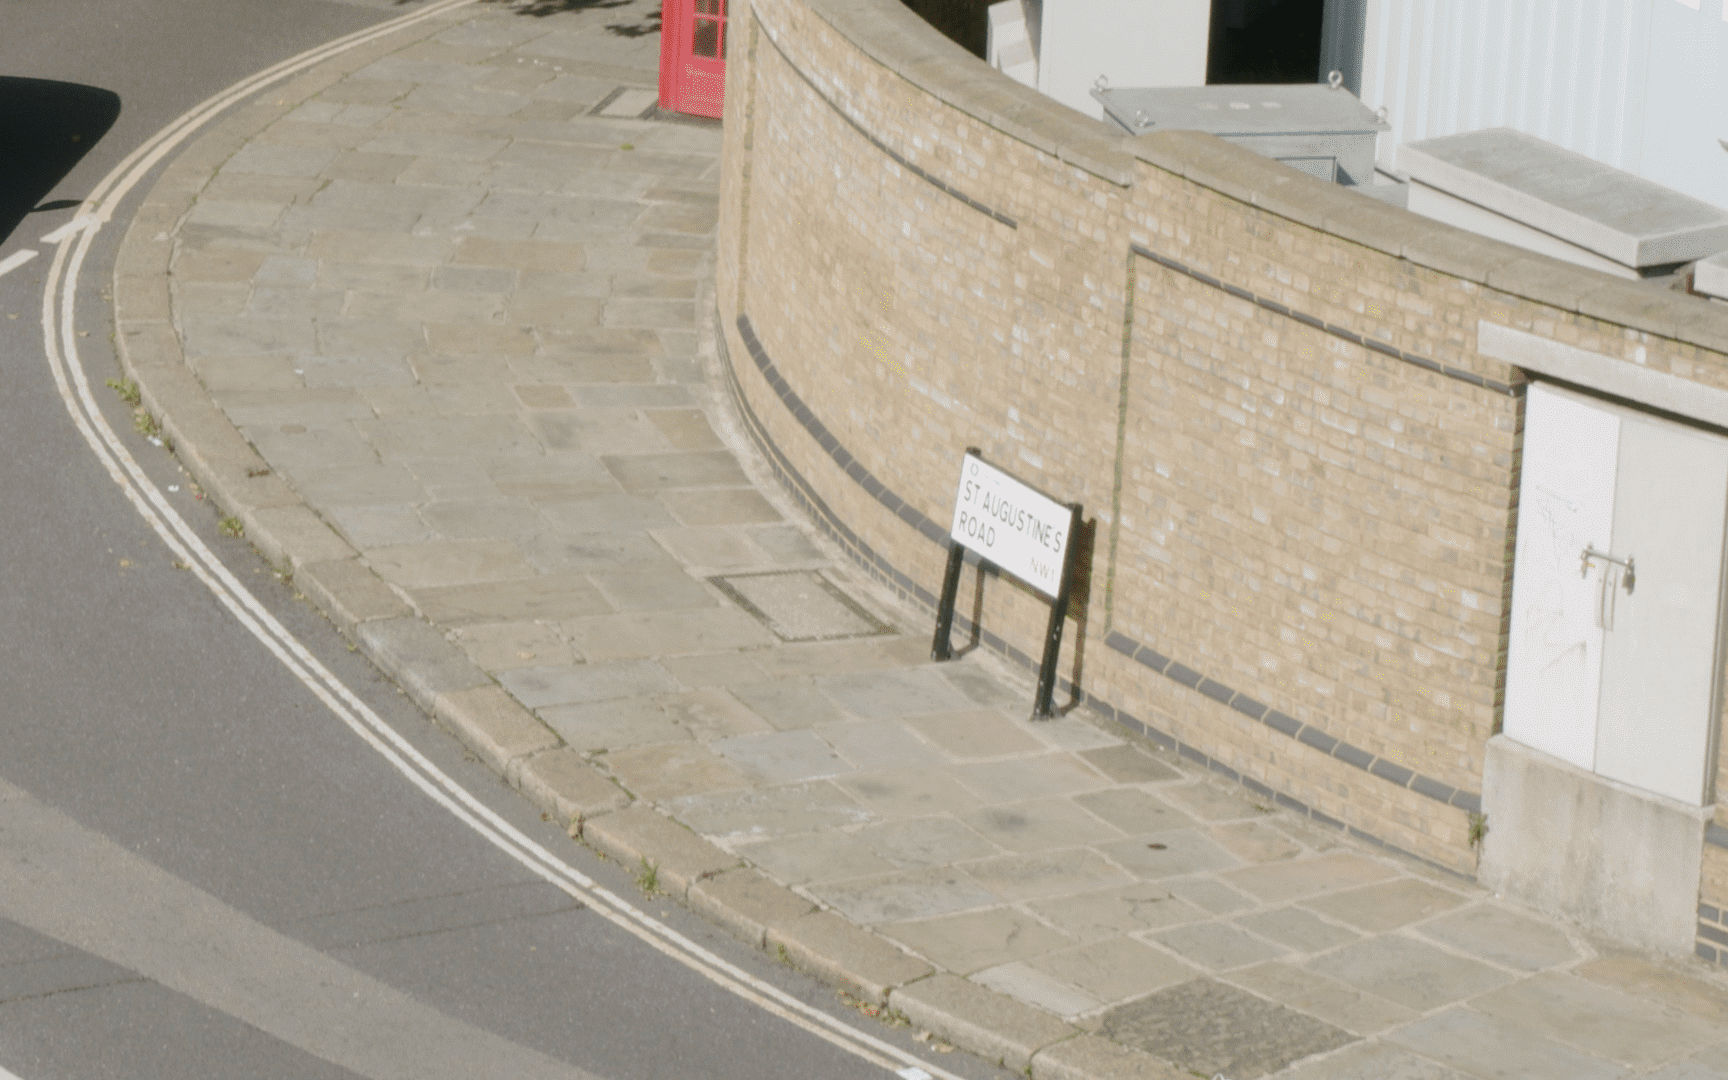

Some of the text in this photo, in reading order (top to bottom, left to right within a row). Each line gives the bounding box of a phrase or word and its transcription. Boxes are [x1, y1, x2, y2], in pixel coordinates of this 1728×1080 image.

[963, 479, 981, 506] ST
[958, 510, 996, 548] ROAD
[1029, 556, 1055, 583] NW1
